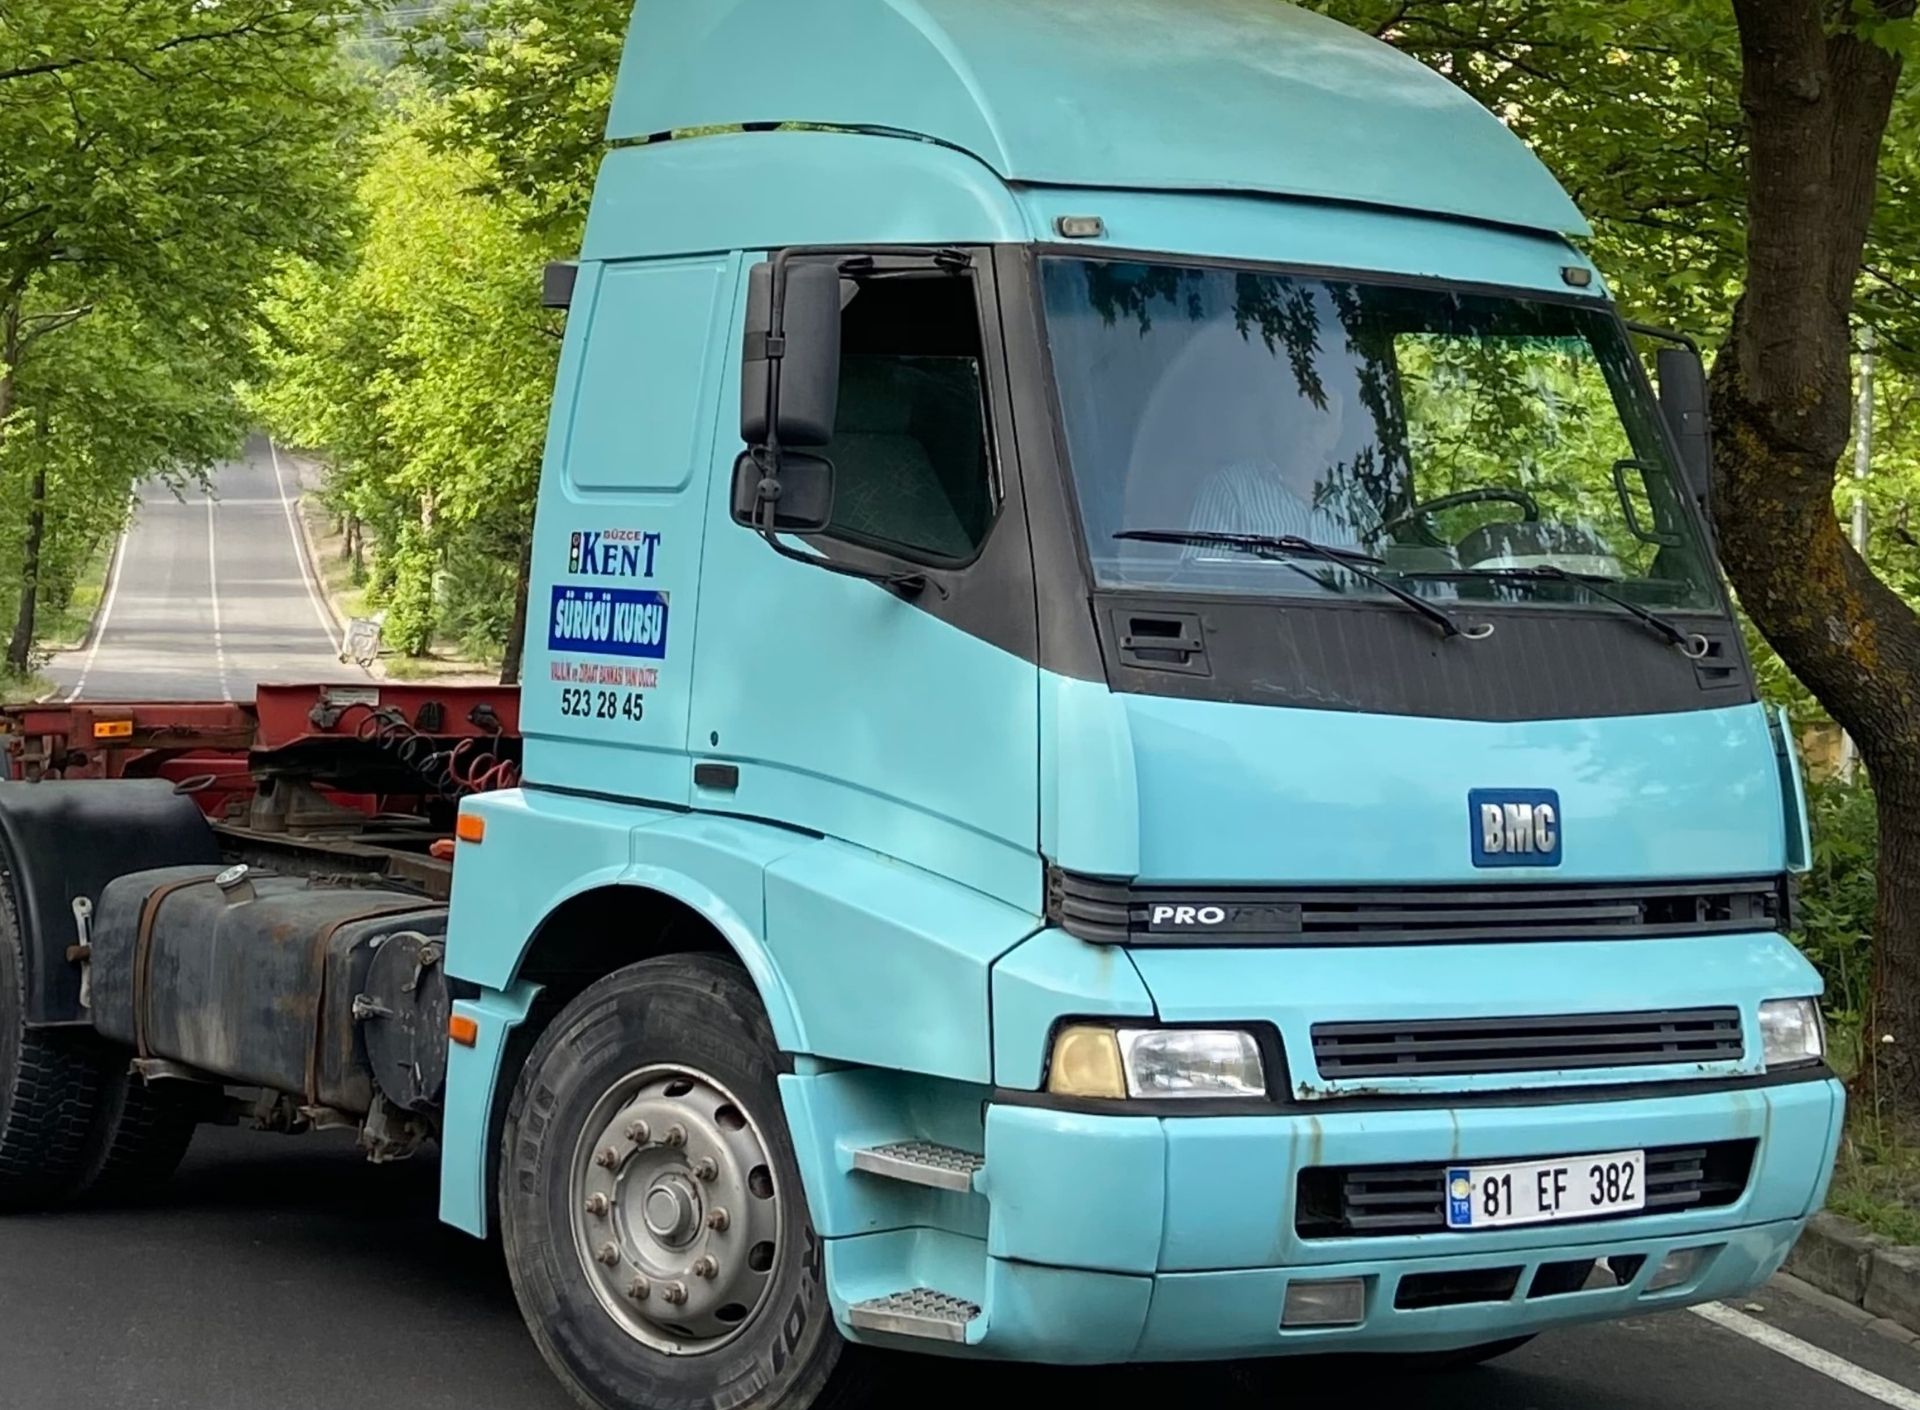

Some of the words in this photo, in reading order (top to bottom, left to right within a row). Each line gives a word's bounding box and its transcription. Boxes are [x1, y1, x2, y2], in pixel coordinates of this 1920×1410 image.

[580, 531, 661, 577] KENT
[554, 590, 611, 641] SÜRÜCÜ
[613, 602, 663, 645] KURSU
[561, 688, 591, 717] 523
[596, 691, 617, 719] 28
[622, 692, 643, 721] 45
[1481, 803, 1556, 853] BMC
[1152, 906, 1226, 924] PRO
[1452, 1201, 1469, 1214] TR
[1483, 1173, 1512, 1217] 81
[1537, 1168, 1568, 1212] EF
[1590, 1161, 1636, 1205] 382
